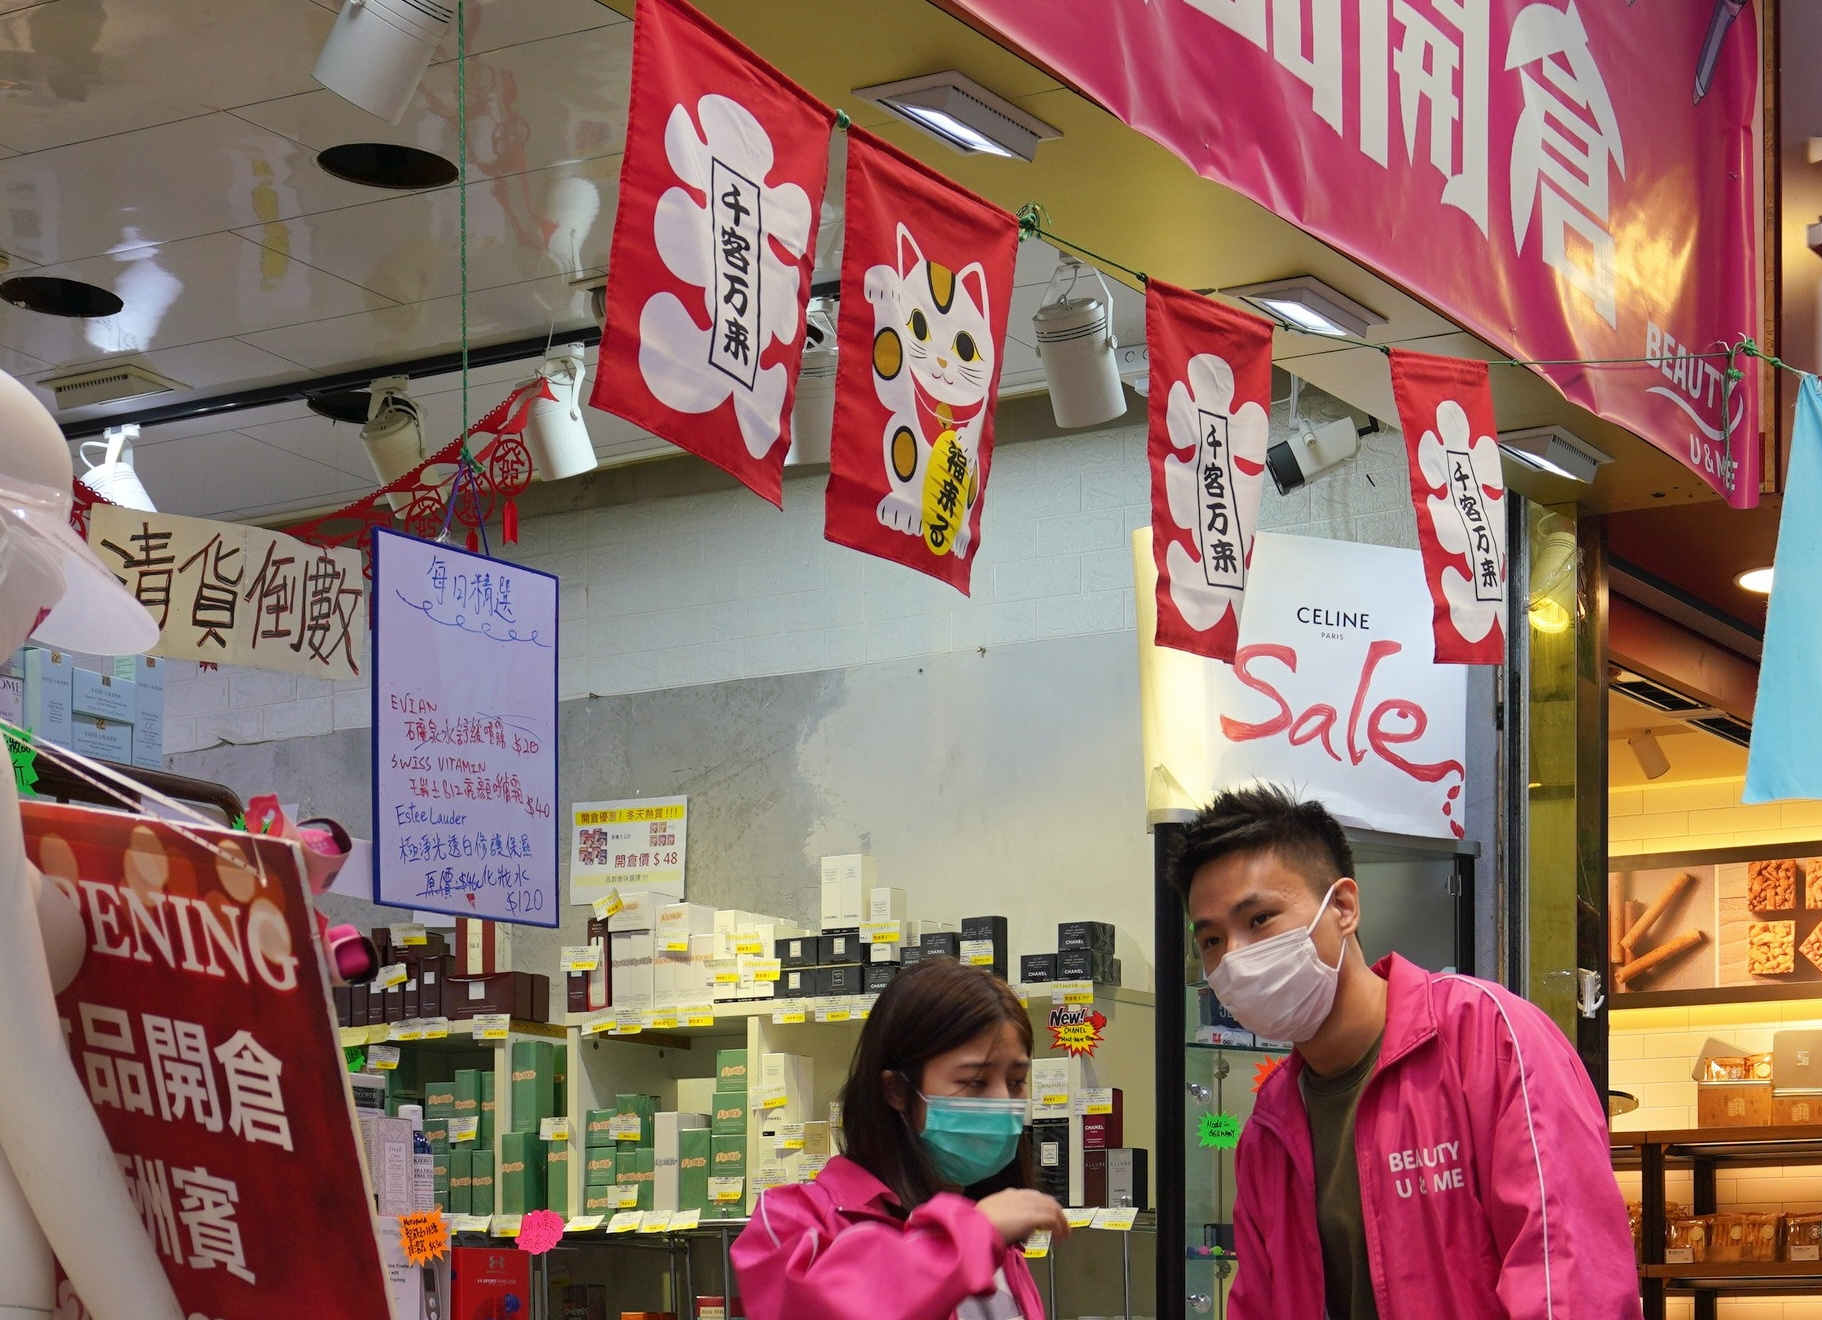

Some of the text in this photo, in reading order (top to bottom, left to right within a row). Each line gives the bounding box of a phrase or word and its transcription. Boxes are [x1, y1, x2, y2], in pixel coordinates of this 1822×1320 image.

[1646, 320, 1738, 408] BEAUTY
[1297, 607, 1370, 630] CELINE
[1321, 632, 1344, 641] PARIS
[391, 693, 437, 713] EVIAN
[1220, 640, 1465, 783] Sale
[506, 889, 543, 916] $120
[1050, 1008, 1086, 1026] New!
[1389, 1140, 1459, 1173] BEAUTY
[1395, 1178, 1412, 1198] U
[1433, 1168, 1464, 1192] ME
